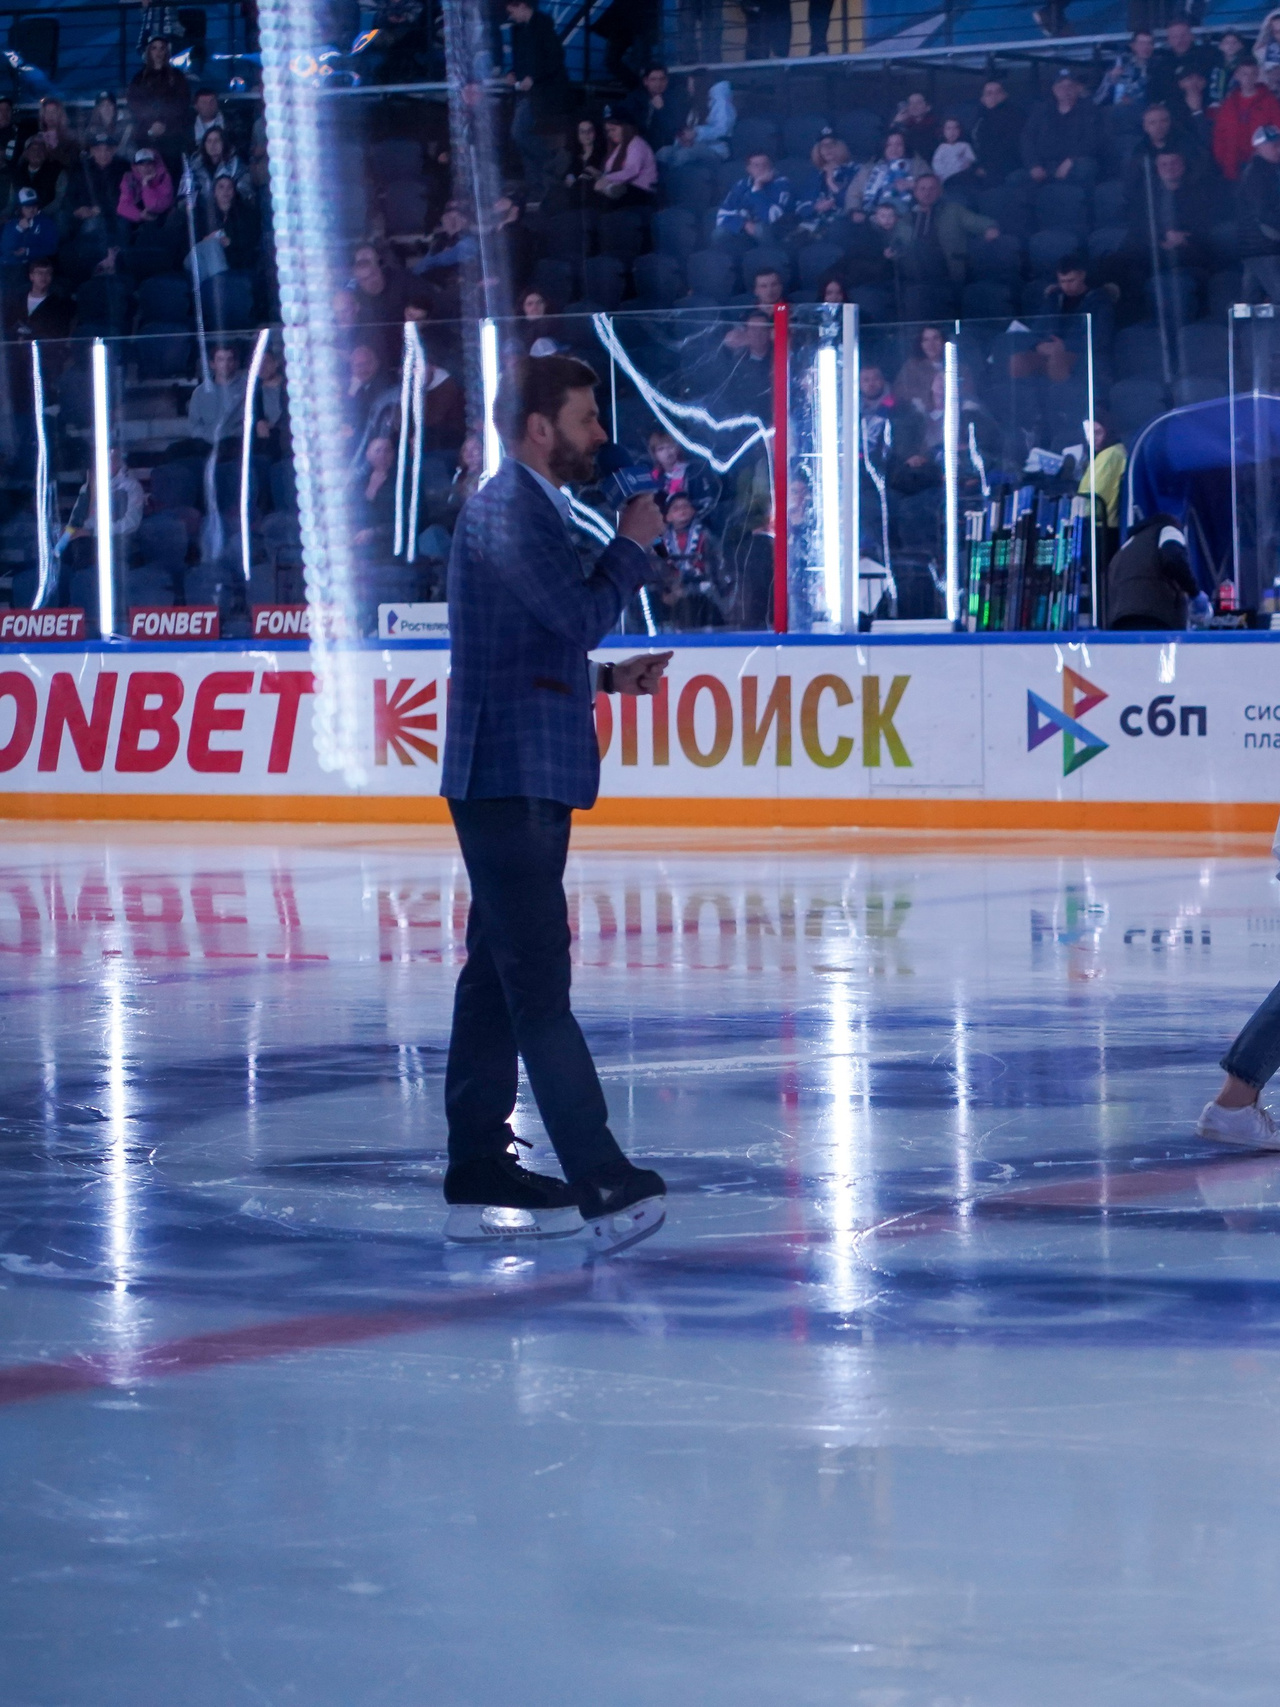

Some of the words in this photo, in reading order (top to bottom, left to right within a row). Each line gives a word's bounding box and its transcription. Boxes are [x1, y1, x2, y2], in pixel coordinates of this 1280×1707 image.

[1, 614, 83, 637] FONBET
[132, 611, 218, 635] FONBET
[374, 674, 914, 767] КПОИСК
[1119, 695, 1208, 738] сбп
